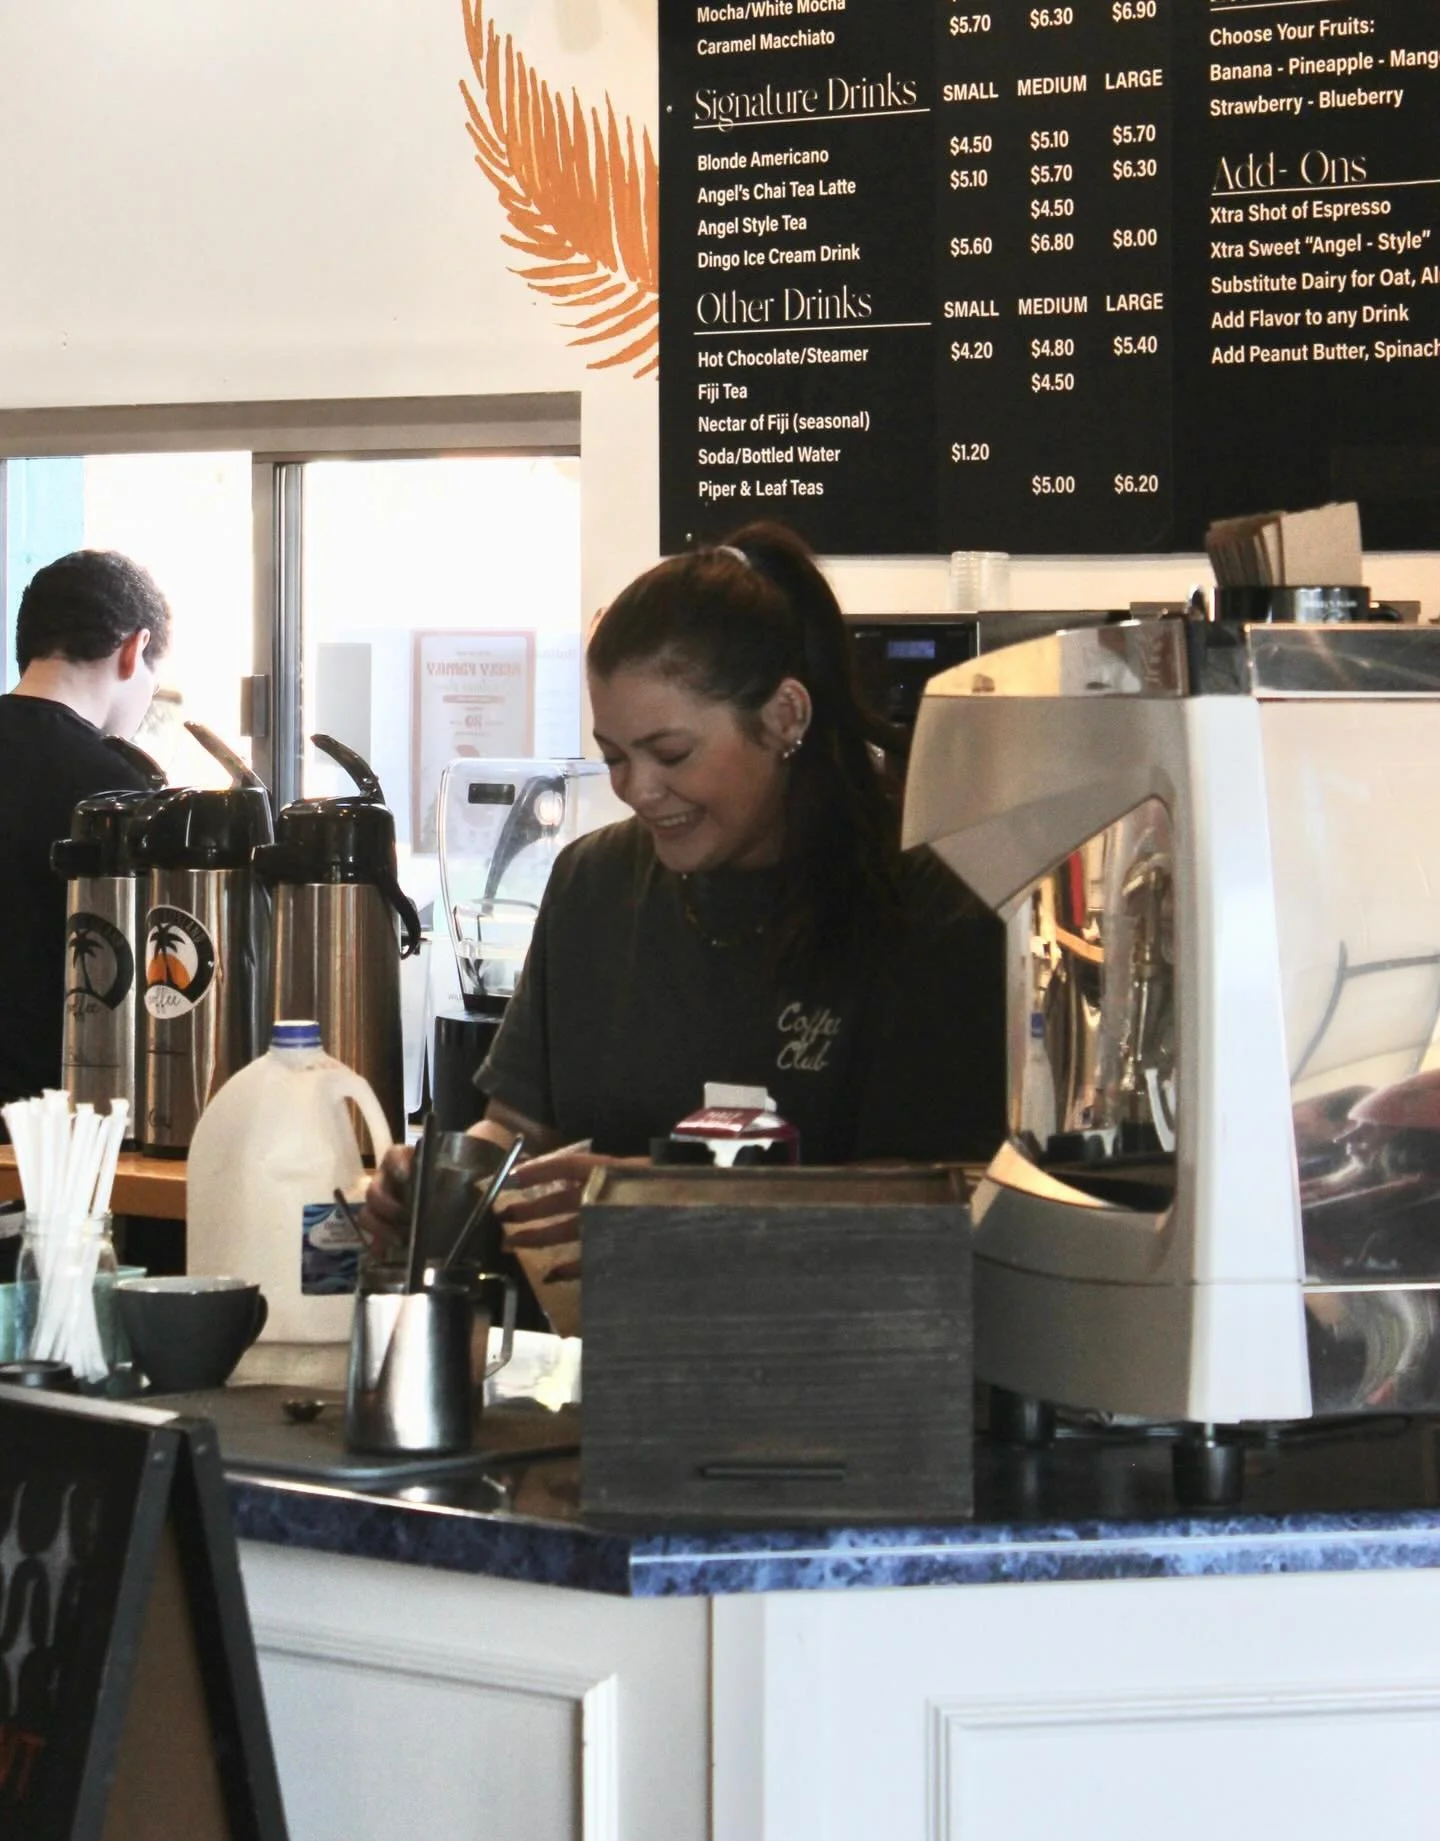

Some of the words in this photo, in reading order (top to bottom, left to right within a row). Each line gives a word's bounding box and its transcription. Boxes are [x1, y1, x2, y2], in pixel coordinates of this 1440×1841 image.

[698, 0, 793, 22] Mocha/White
[797, 0, 845, 13] Mocha
[950, 14, 991, 36] $5.70
[1030, 7, 1073, 29] $6.30
[1112, 0, 1156, 22] $6.90
[697, 34, 756, 55] Caramel
[760, 29, 835, 50] Macchiato
[1210, 28, 1272, 46] Choose
[1277, 23, 1315, 40] Your
[1320, 17, 1374, 37] Fruits:
[1210, 64, 1272, 81] Banana
[1289, 52, 1373, 76] Pineapple
[1390, 49, 1440, 69] Mang
[943, 82, 999, 101] SMALL
[1018, 75, 1086, 96] MEDIUM
[1106, 69, 1163, 90] LARGE
[694, 85, 819, 132] Signature
[829, 72, 917, 111] Drinks
[1210, 95, 1303, 116] Strawberry
[1319, 88, 1403, 108] Blueberry
[950, 135, 992, 156] $4.50
[1031, 130, 1069, 151] $5.10
[1113, 124, 1156, 145] $5.70
[698, 152, 747, 171] Blonde
[750, 148, 829, 167] Americano
[1213, 152, 1288, 191] Add-
[1301, 151, 1368, 185] Ons
[950, 169, 987, 190] $5.10
[1031, 164, 1072, 185] $5.70
[1113, 159, 1157, 180] $6.30
[698, 184, 750, 206] Angel's
[753, 181, 786, 200] Chai
[789, 181, 815, 197] Tea
[819, 179, 856, 195] Latte
[1031, 199, 1074, 219] $4.50
[1211, 207, 1243, 224] Xtra
[1249, 203, 1287, 221] Shot
[1292, 201, 1308, 219] of
[1313, 201, 1391, 221] Espresso
[698, 218, 738, 239] Angel
[743, 216, 778, 236] Style
[782, 215, 807, 230] Tea
[951, 237, 992, 257] $5.60
[1031, 233, 1074, 253] $6.80
[1113, 229, 1157, 249] $8.00
[1211, 242, 1244, 258] Xtra
[1249, 239, 1300, 256] Sweet
[698, 251, 740, 271] Dingo
[744, 250, 765, 265] Ice
[769, 248, 816, 264] Cream
[821, 243, 860, 261] Drink
[1212, 274, 1296, 294] Substitute
[1302, 271, 1346, 292] Dairy
[1351, 270, 1375, 287] for
[1380, 269, 1416, 287] Oat,
[1421, 266, 1440, 284] Al
[697, 290, 774, 324] Other
[785, 285, 871, 320] Drinks
[944, 300, 999, 318] SMALL
[1019, 296, 1087, 315] MEDIUM
[1106, 293, 1163, 311] LARGE
[1212, 310, 1244, 328] Add
[1250, 310, 1301, 327] Flavor
[1305, 309, 1322, 325] to
[1327, 310, 1357, 328] any
[1363, 304, 1409, 323] Drink
[698, 352, 723, 367] Hot
[727, 347, 868, 366] Chocolate/Steamer
[951, 342, 993, 361] $4.20
[1031, 339, 1074, 358] $4.80
[1114, 336, 1157, 356] $5.40
[1212, 345, 1245, 364] Add
[1250, 345, 1308, 362] Peanut
[1313, 344, 1369, 360] Butter,
[698, 383, 719, 404] Fiji
[723, 383, 747, 399] Tea
[1032, 373, 1074, 392] $4.50
[699, 416, 746, 432] Nectar
[750, 414, 764, 431] of
[768, 413, 789, 434] Fiji
[793, 411, 869, 433] (seasonal)
[699, 446, 793, 464] Soda/Bottled
[797, 446, 840, 462] Water
[952, 443, 989, 462] $1.20
[699, 481, 736, 501] Piper
[740, 481, 751, 496] &
[756, 479, 787, 496] Leaf
[790, 480, 823, 495] Teas
[1032, 475, 1075, 495] $5.00
[1115, 474, 1158, 494] $6.20
[777, 1041, 831, 1071] Club
